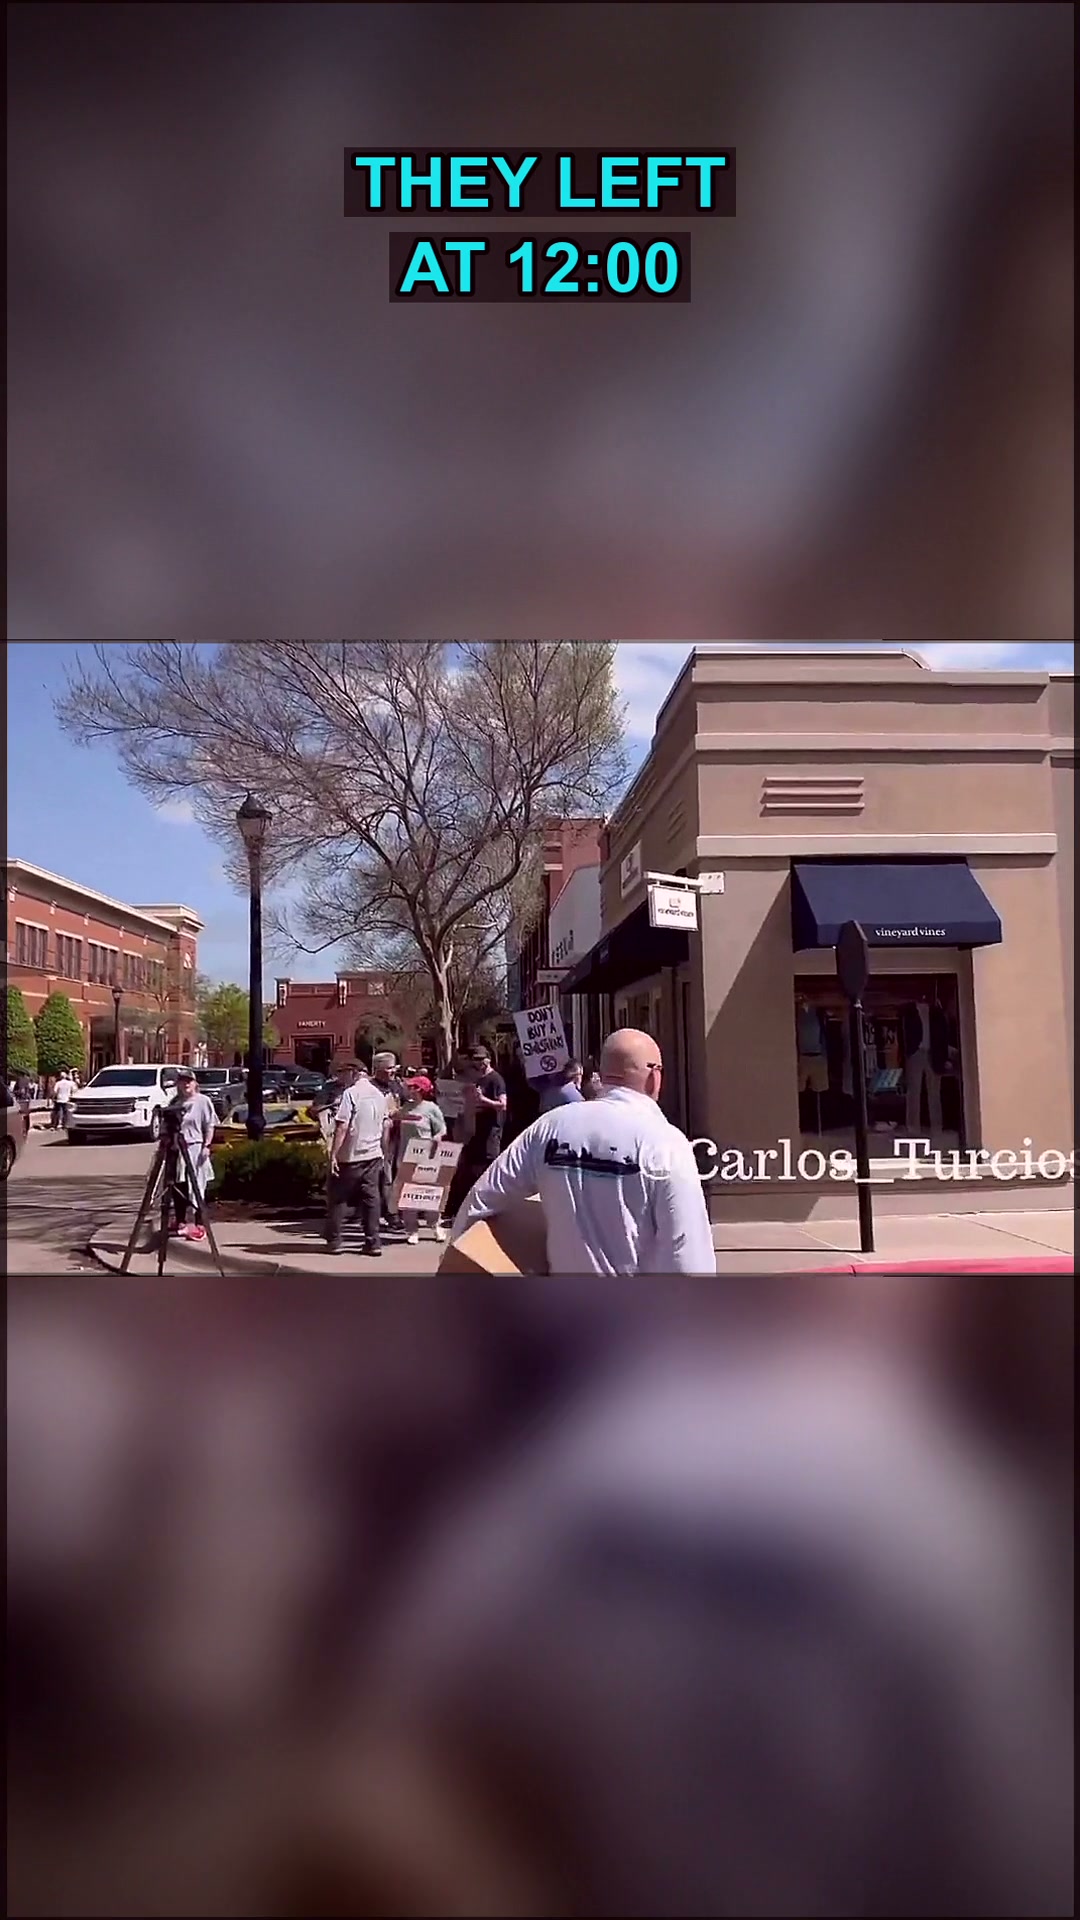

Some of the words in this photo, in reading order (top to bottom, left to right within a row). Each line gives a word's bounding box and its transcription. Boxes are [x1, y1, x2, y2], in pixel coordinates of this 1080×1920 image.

[875, 926, 919, 939] vineyard
[919, 926, 946, 936] vines
[527, 1023, 546, 1040] BUY
[550, 1022, 557, 1034] A
